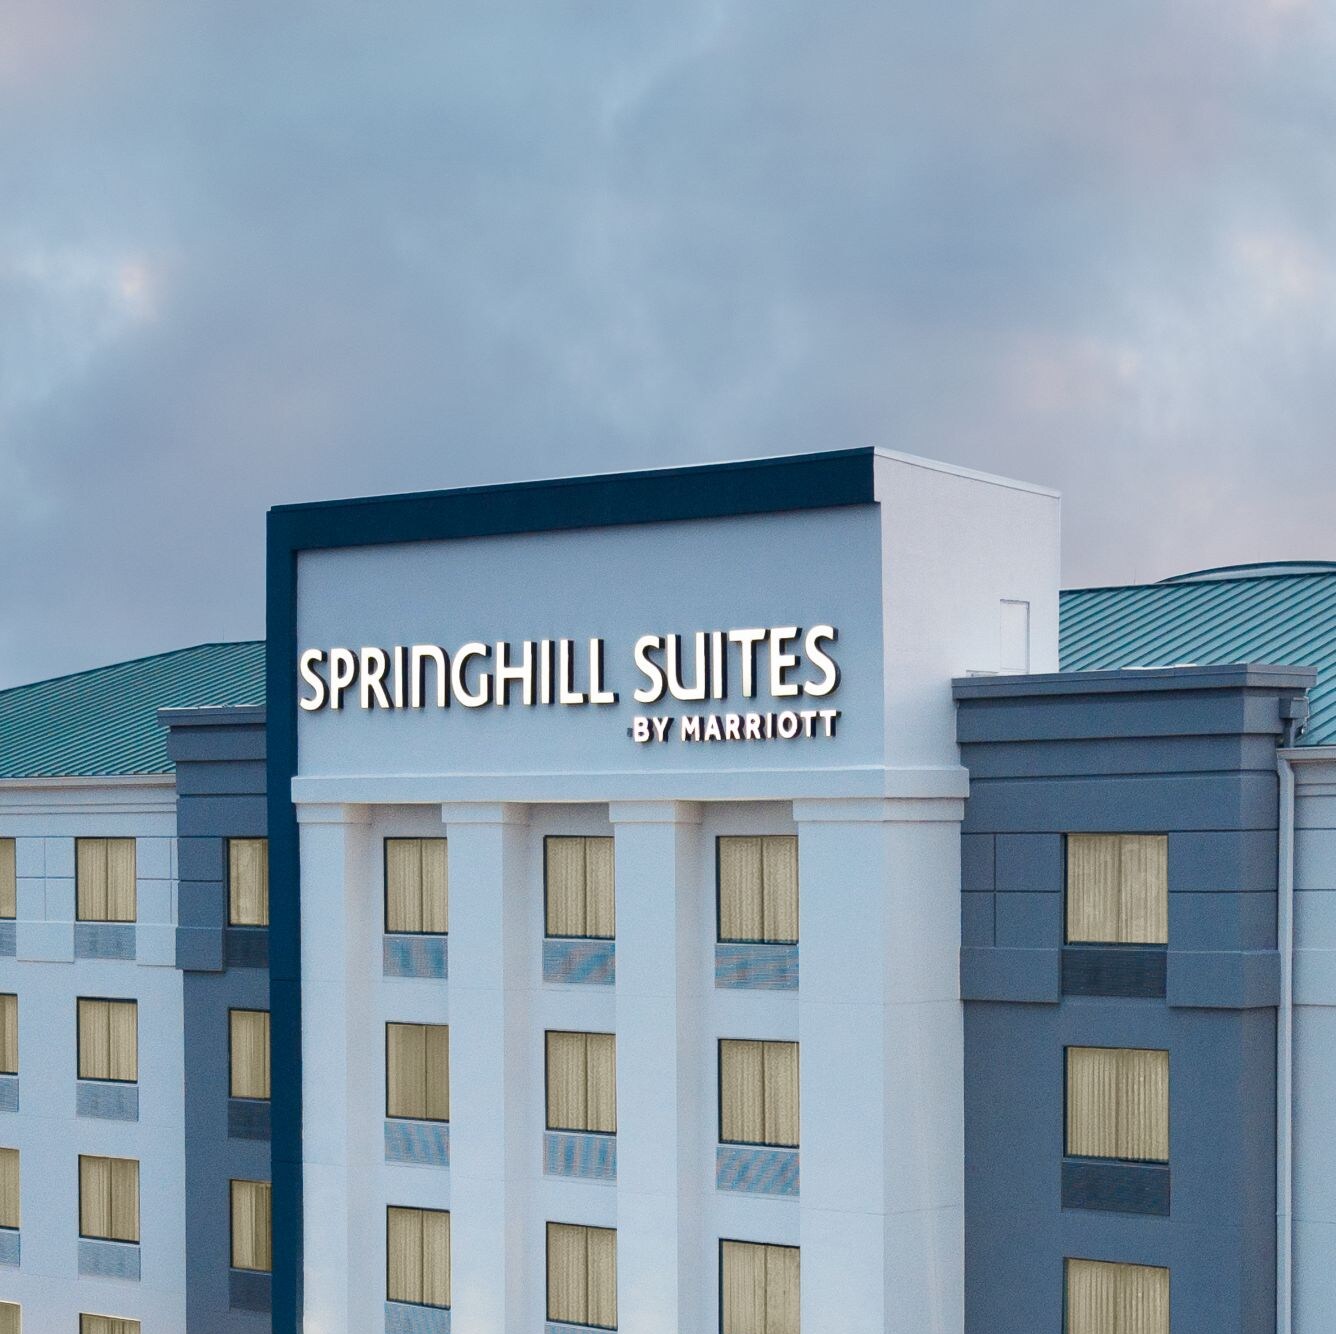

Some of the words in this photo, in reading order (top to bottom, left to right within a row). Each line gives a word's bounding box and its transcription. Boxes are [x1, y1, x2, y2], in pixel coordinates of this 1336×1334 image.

[300, 638, 617, 711] SPRINGHILL
[633, 624, 840, 704] SUITES
[633, 715, 671, 743] BY
[681, 709, 839, 742] MARRIOTT
